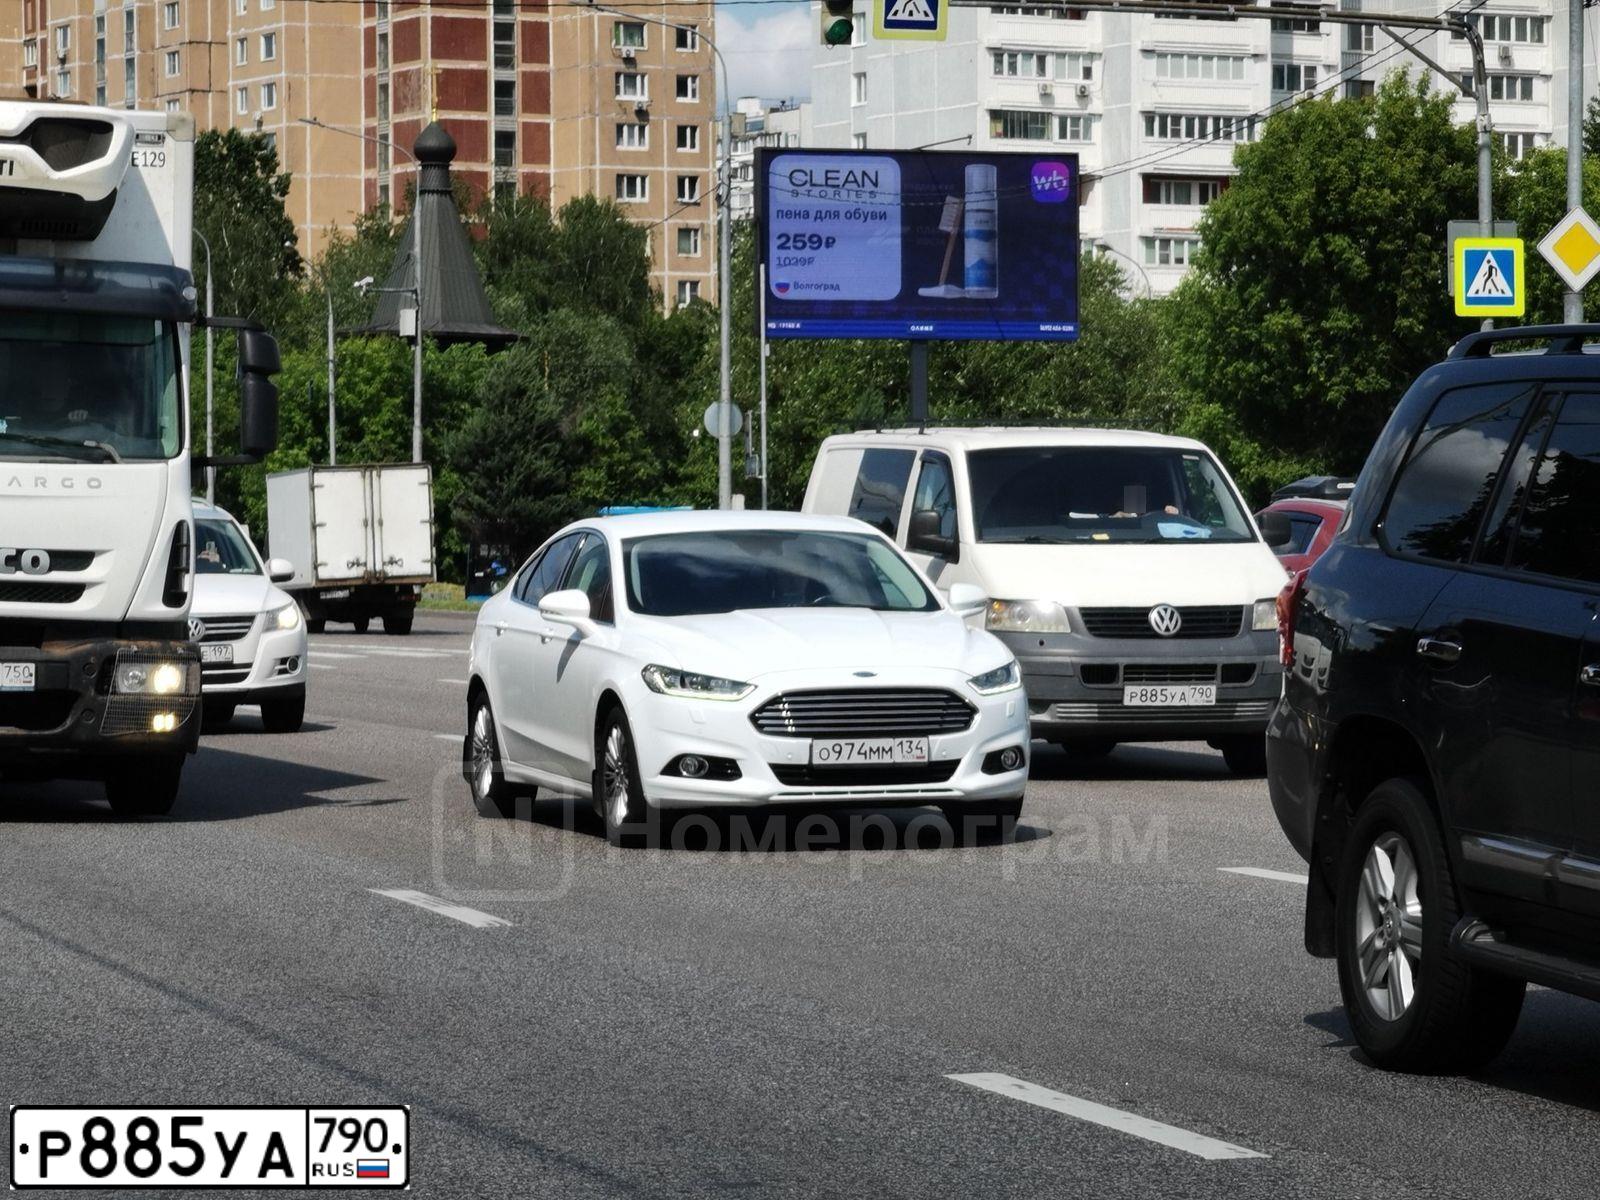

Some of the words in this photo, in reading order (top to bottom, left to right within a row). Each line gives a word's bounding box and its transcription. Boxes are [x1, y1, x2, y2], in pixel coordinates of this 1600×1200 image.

[788, 169, 879, 188] CLEAN
[790, 189, 877, 199] STORIES
[776, 209, 810, 220] пена
[813, 209, 840, 222] для
[844, 208, 887, 223] обуви
[793, 281, 840, 291] Волгоград
[4, 665, 30, 678] 750
